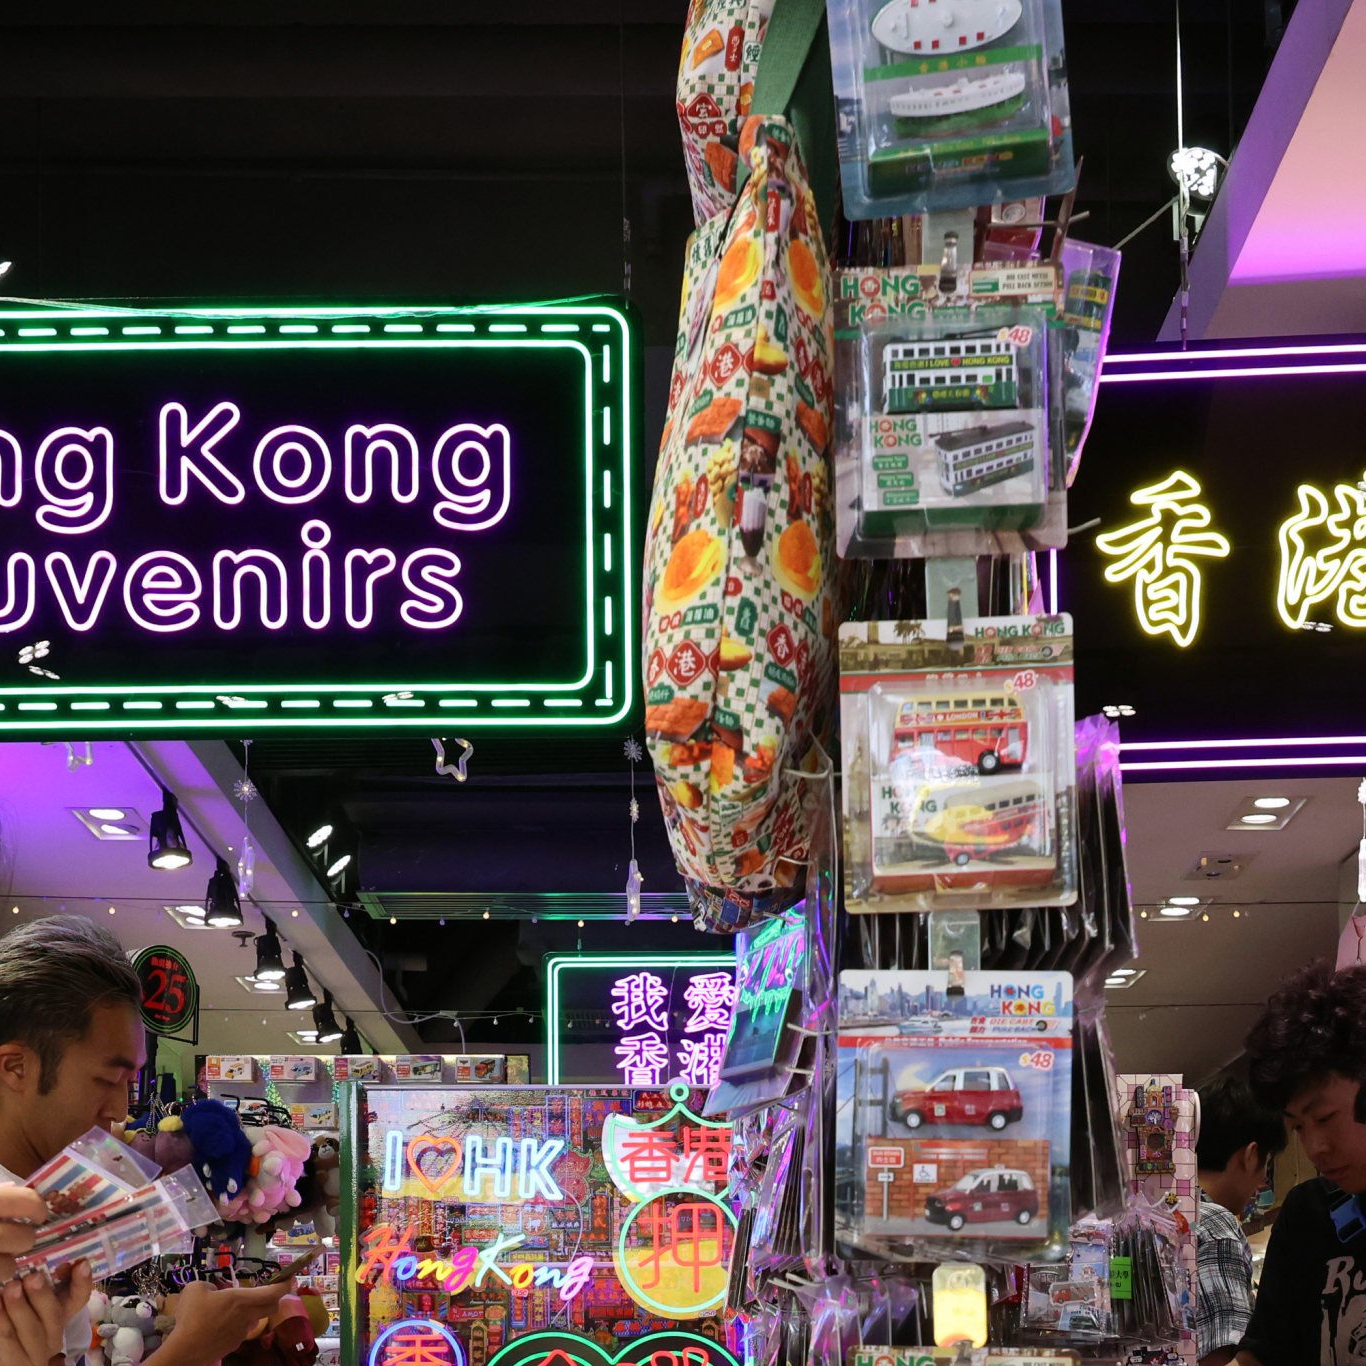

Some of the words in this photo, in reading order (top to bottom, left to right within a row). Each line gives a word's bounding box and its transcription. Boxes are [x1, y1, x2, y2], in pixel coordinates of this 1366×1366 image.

[841, 274, 921, 299] HONG
[848, 301, 927, 327] KONG
[715, 350, 734, 378] 港
[962, 356, 985, 367] HONG
[986, 354, 1011, 366] KONG
[873, 433, 923, 449] KONG
[156, 400, 511, 533] Kong
[974, 625, 1019, 639] HONG
[1021, 621, 1065, 637] KONG
[674, 651, 697, 678] 港
[990, 984, 1044, 999] HONG
[1001, 1000, 1056, 1016] KONG
[383, 1130, 403, 1192] I
[463, 1134, 565, 1200] HK
[620, 1126, 732, 1184] 香港
[638, 1201, 723, 1294] 押
